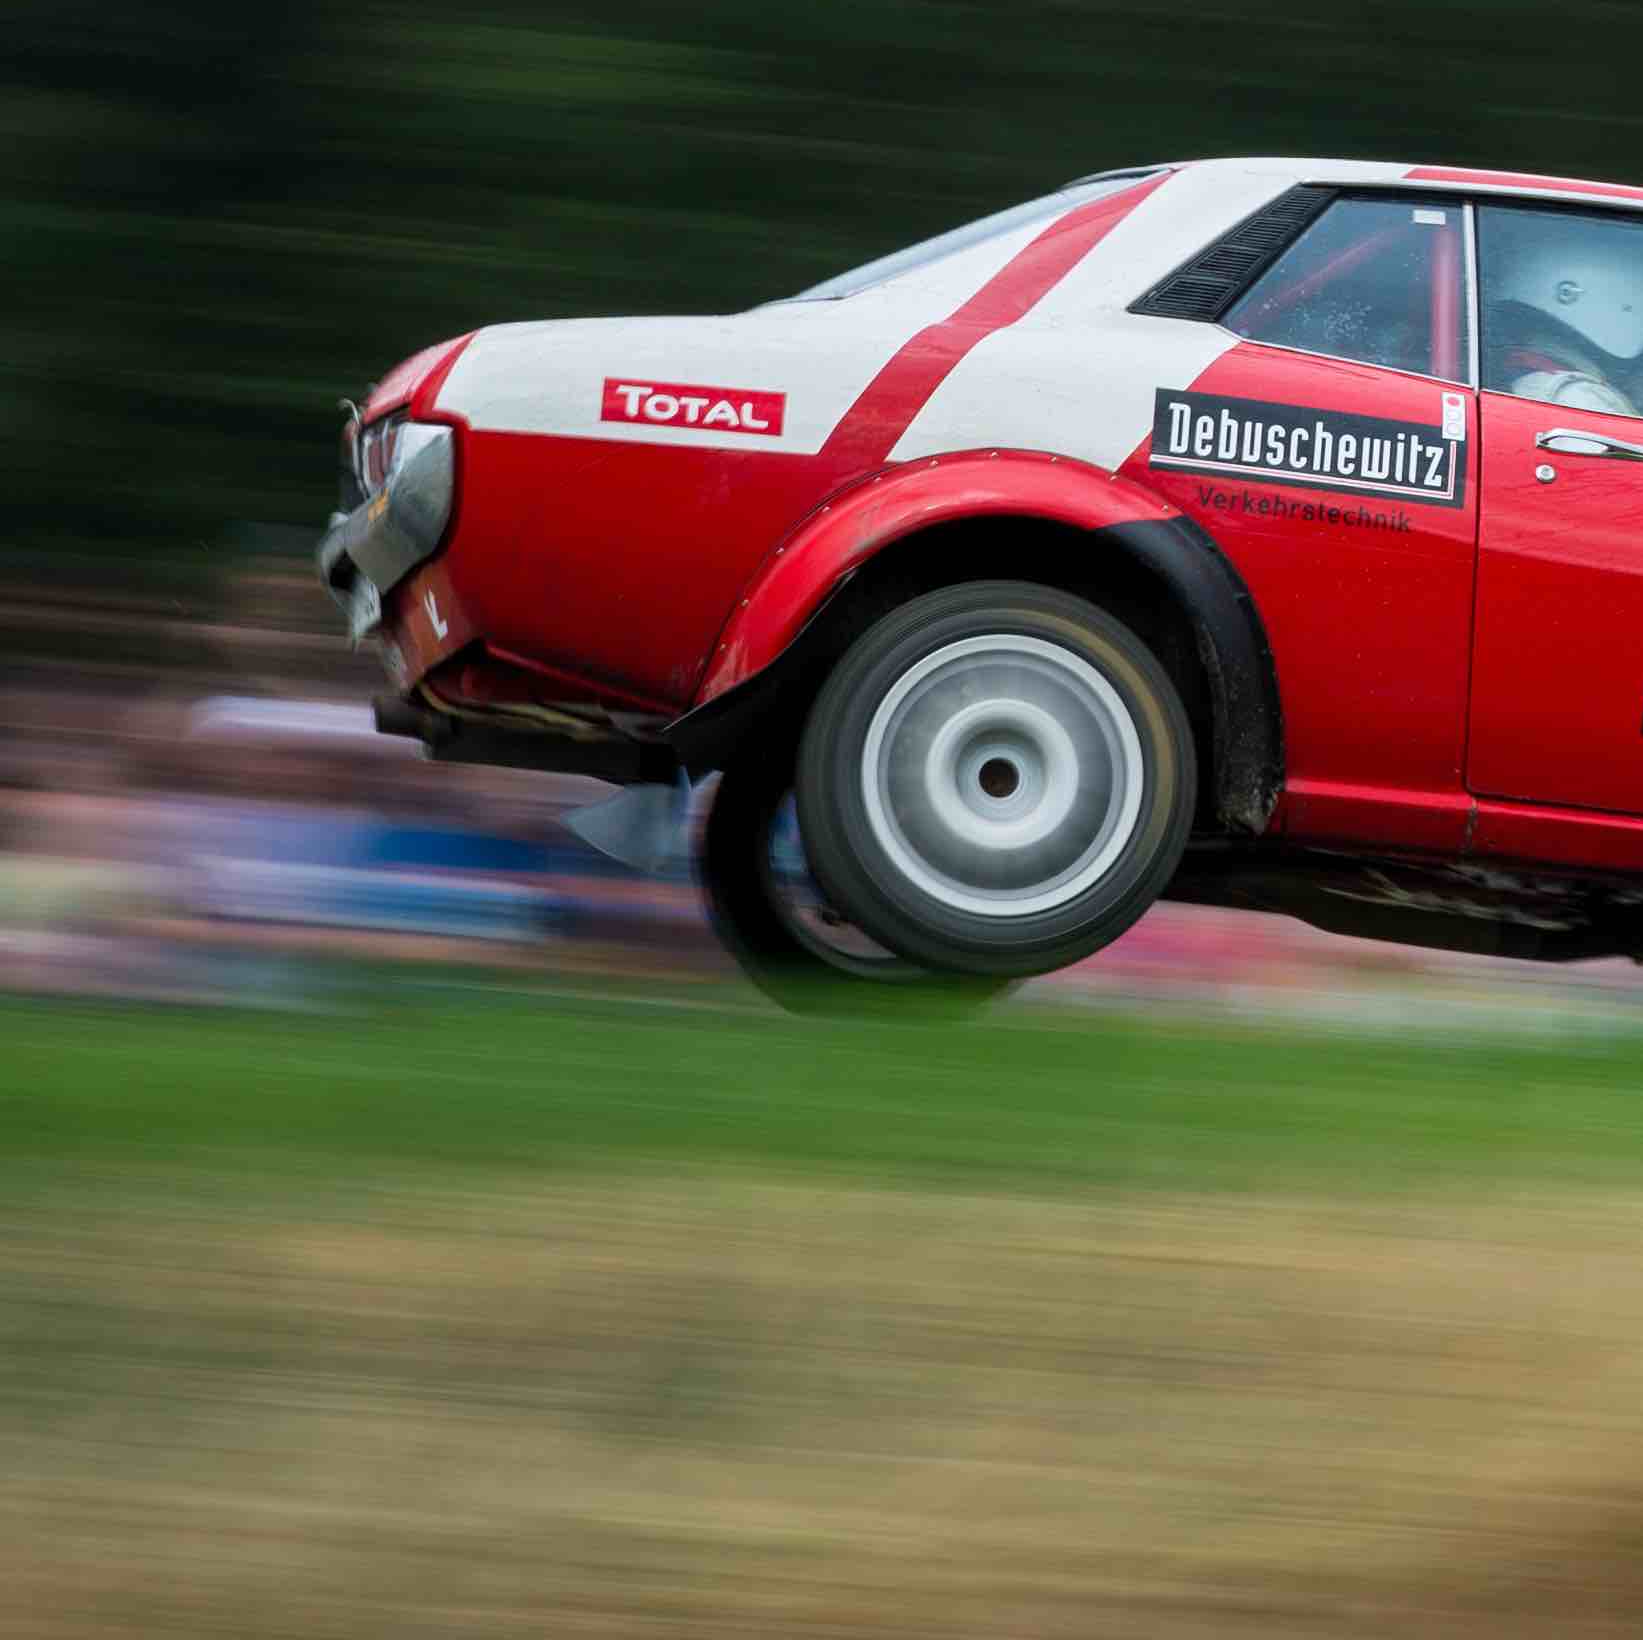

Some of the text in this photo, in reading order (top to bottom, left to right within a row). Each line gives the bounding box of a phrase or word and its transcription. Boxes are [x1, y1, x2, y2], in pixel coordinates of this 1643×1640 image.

[616, 384, 769, 429] TOTAL
[1168, 402, 1445, 487] Debuschewitz
[1198, 486, 1413, 532] Verkehrstechnik
